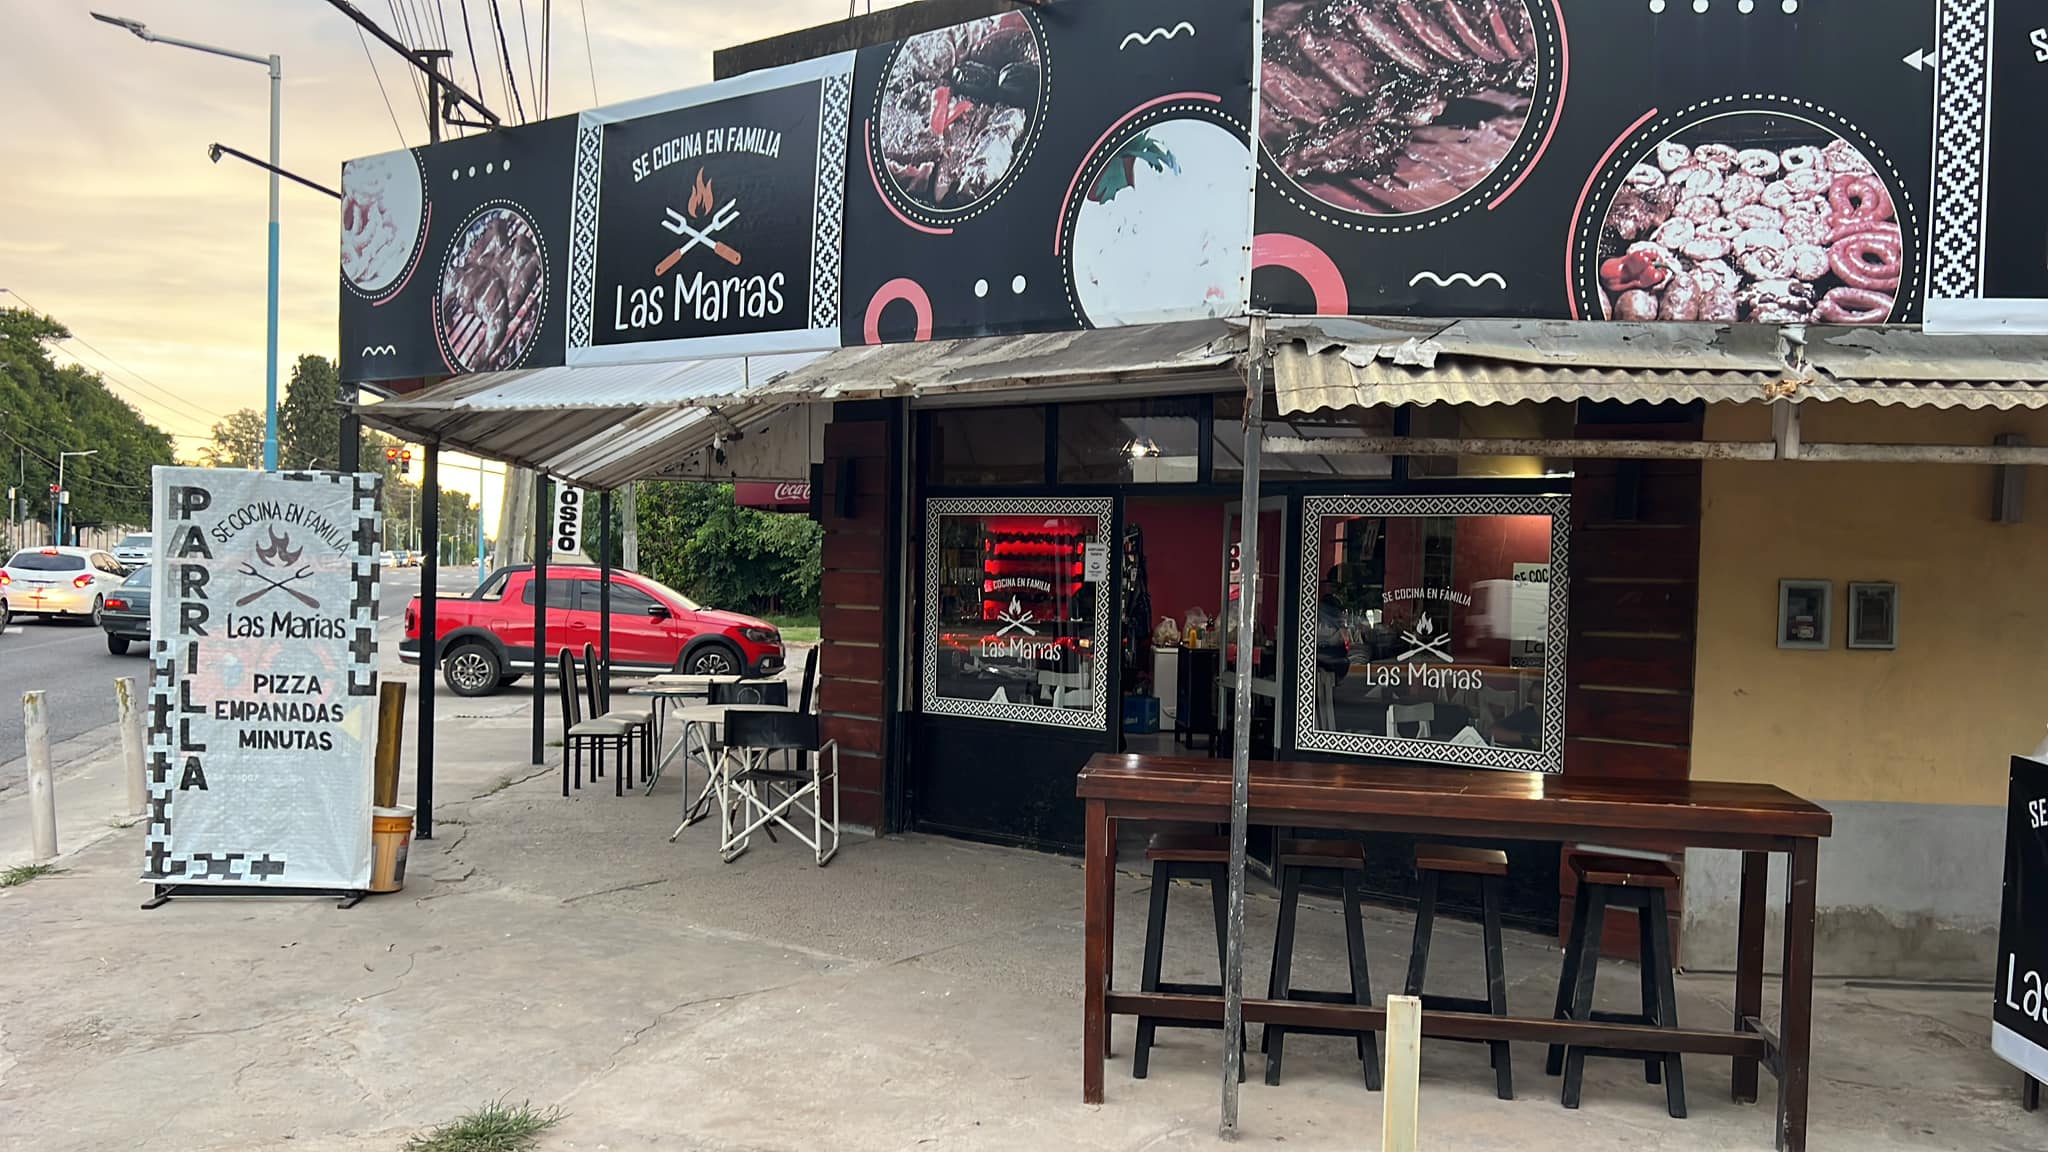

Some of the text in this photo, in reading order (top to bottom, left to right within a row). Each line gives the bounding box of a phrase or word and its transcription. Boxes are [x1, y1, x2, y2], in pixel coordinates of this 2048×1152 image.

[632, 127, 781, 182] SE COCINA EN FAMILIA
[615, 271, 785, 330] Las Marías
[211, 501, 351, 559] SE COCINA EN FAMILIA
[558, 489, 578, 551] OSCO
[993, 578, 1017, 590] COCINA
[1017, 578, 1026, 587] EN
[1026, 579, 1051, 593] FAMILIA
[1382, 588, 1472, 607] SE COCINA EN FAMILIA
[227, 612, 265, 639] Las
[178, 486, 213, 792] PARRILLA
[982, 639, 1005, 658] Las
[253, 674, 322, 695] PIZZA
[1366, 663, 1401, 687] Las
[215, 701, 344, 723] EMPANADAS
[239, 729, 333, 751] MINUTAS
[2029, 798, 2048, 829] SE
